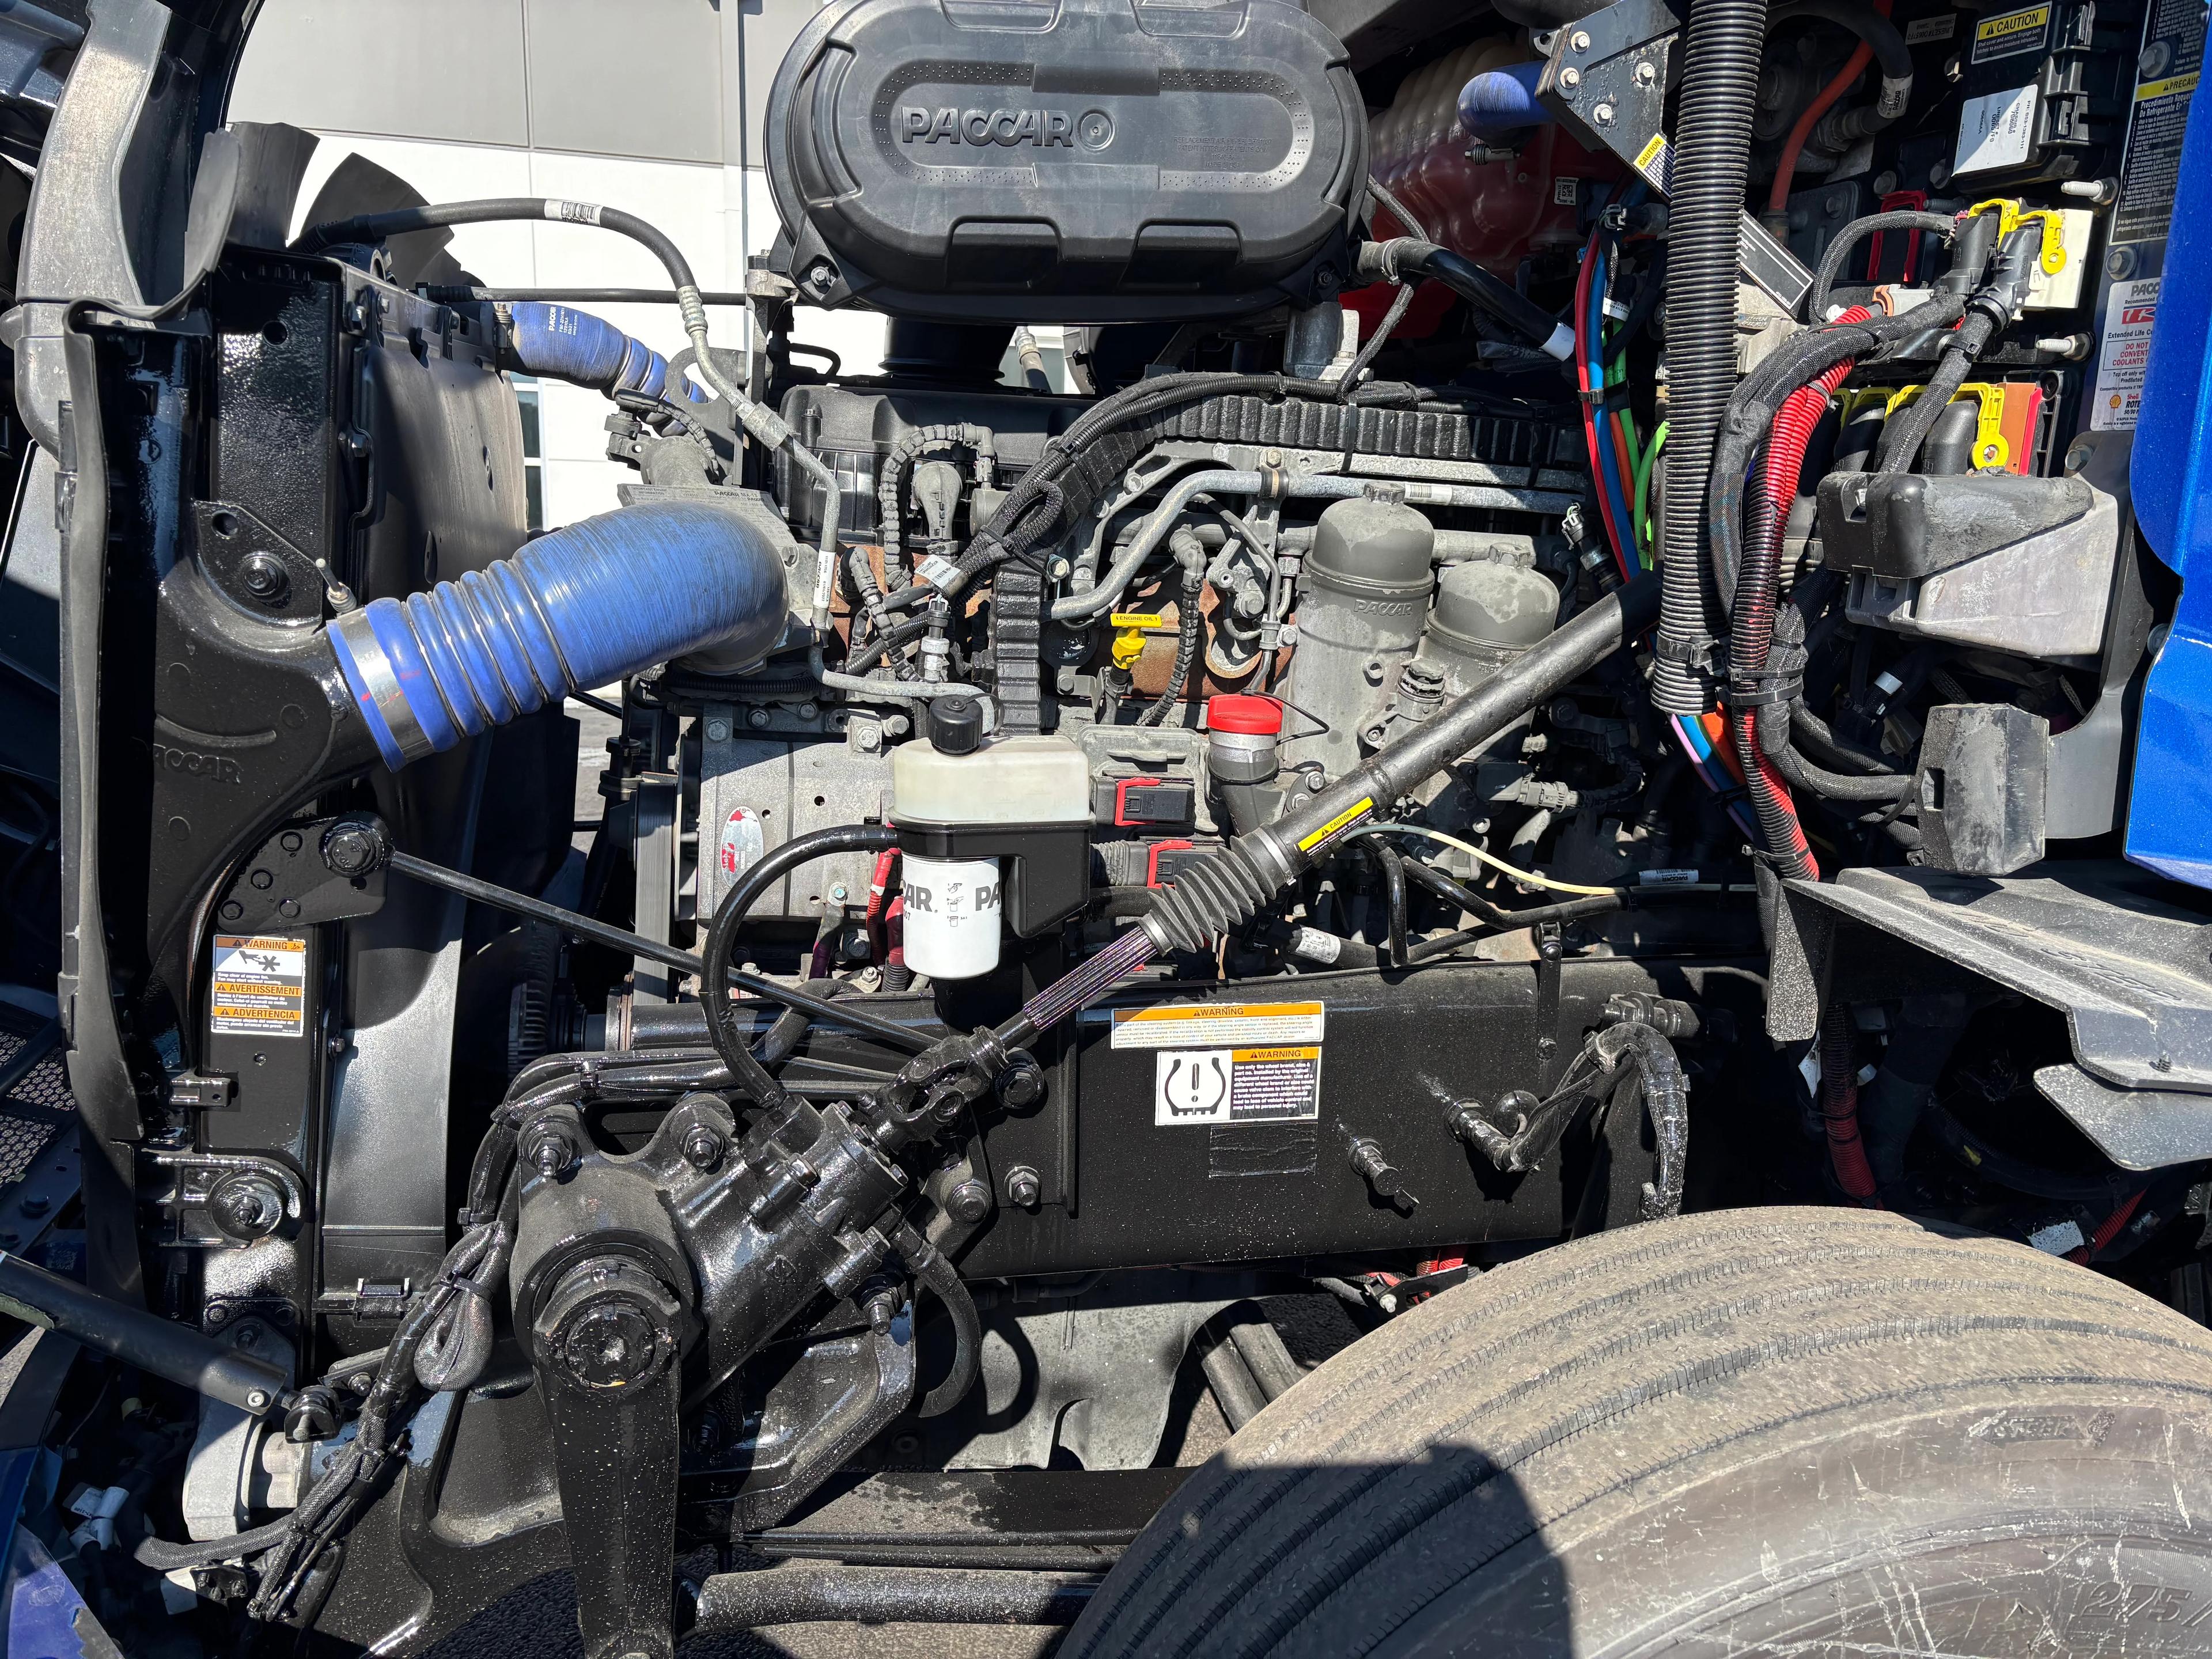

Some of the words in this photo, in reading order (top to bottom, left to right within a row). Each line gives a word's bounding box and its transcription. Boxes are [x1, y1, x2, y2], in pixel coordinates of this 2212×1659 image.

[1997, 13, 2039, 32] CAUTION
[1892, 90, 1901, 110] PACCAR
[901, 105, 1073, 147] PACCAR
[1639, 140, 1661, 166] CAUTION
[2113, 358, 2143, 366] COOLANTS
[1353, 599, 1413, 616] PACCAR
[1330, 812, 1351, 829] CAUTION
[245, 940, 287, 949] WARNING
[229, 984, 300, 995] AVERTISSEMENT
[233, 1009, 295, 1019] ADVERTENCIA
[1200, 1007, 1244, 1017] WARNING
[1258, 1050, 1301, 1058] WARNING
